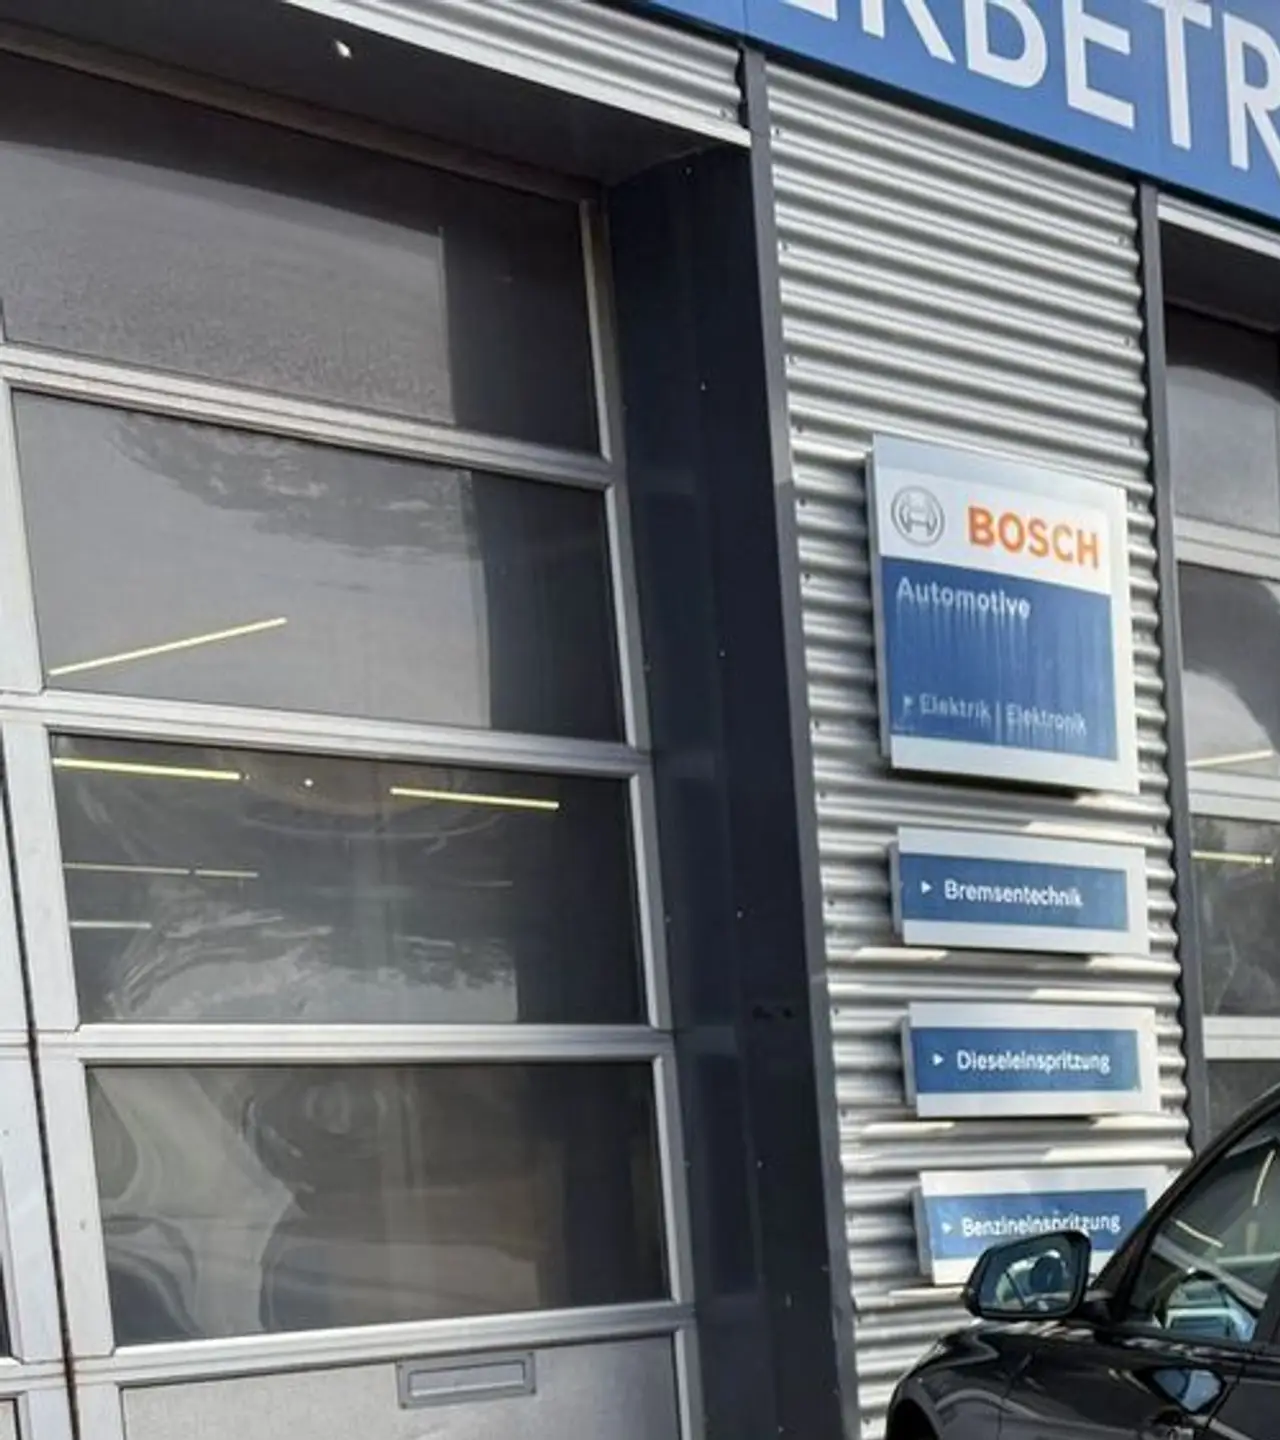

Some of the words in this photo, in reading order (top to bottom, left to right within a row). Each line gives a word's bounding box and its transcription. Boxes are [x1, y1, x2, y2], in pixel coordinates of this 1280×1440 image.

[967, 505, 1100, 570] BOSCH
[896, 577, 1032, 620] Automotive
[919, 693, 993, 726] Elektrik
[1006, 702, 1088, 737] Elektronik
[943, 878, 1084, 909] Bremsentechnik
[956, 1049, 1112, 1075] Dieseleinspritzung
[960, 1213, 1122, 1238] Benzineinspritzung
